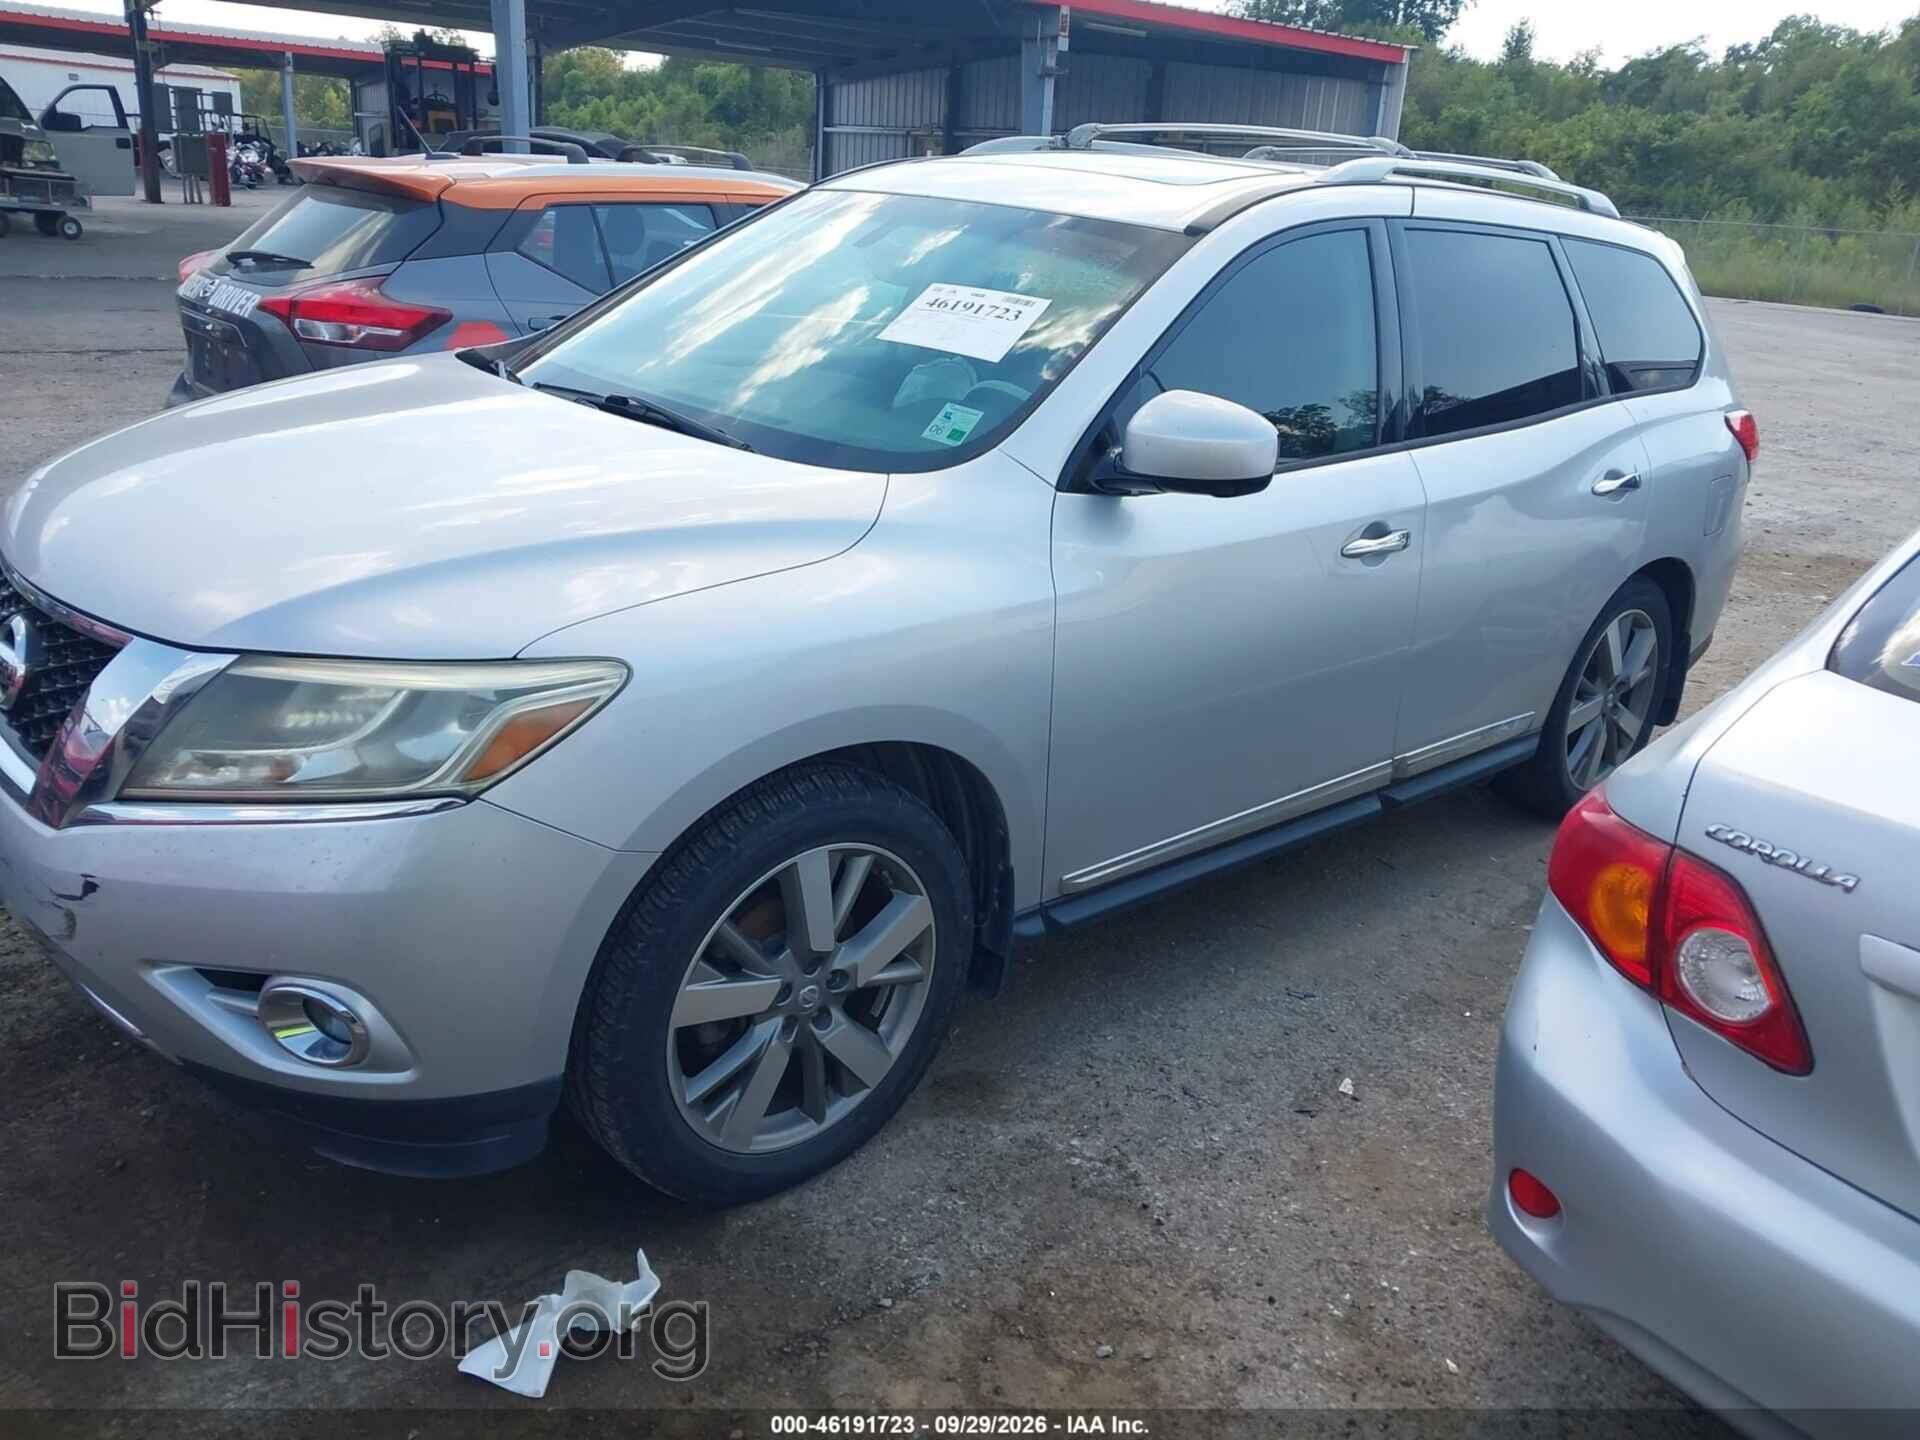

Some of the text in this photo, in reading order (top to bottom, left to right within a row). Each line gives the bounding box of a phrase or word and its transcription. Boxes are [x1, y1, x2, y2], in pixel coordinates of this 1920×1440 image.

[208, 284, 261, 318] DRIVER
[925, 297, 1023, 322] 46191723
[1705, 823, 1860, 892] COROLLA
